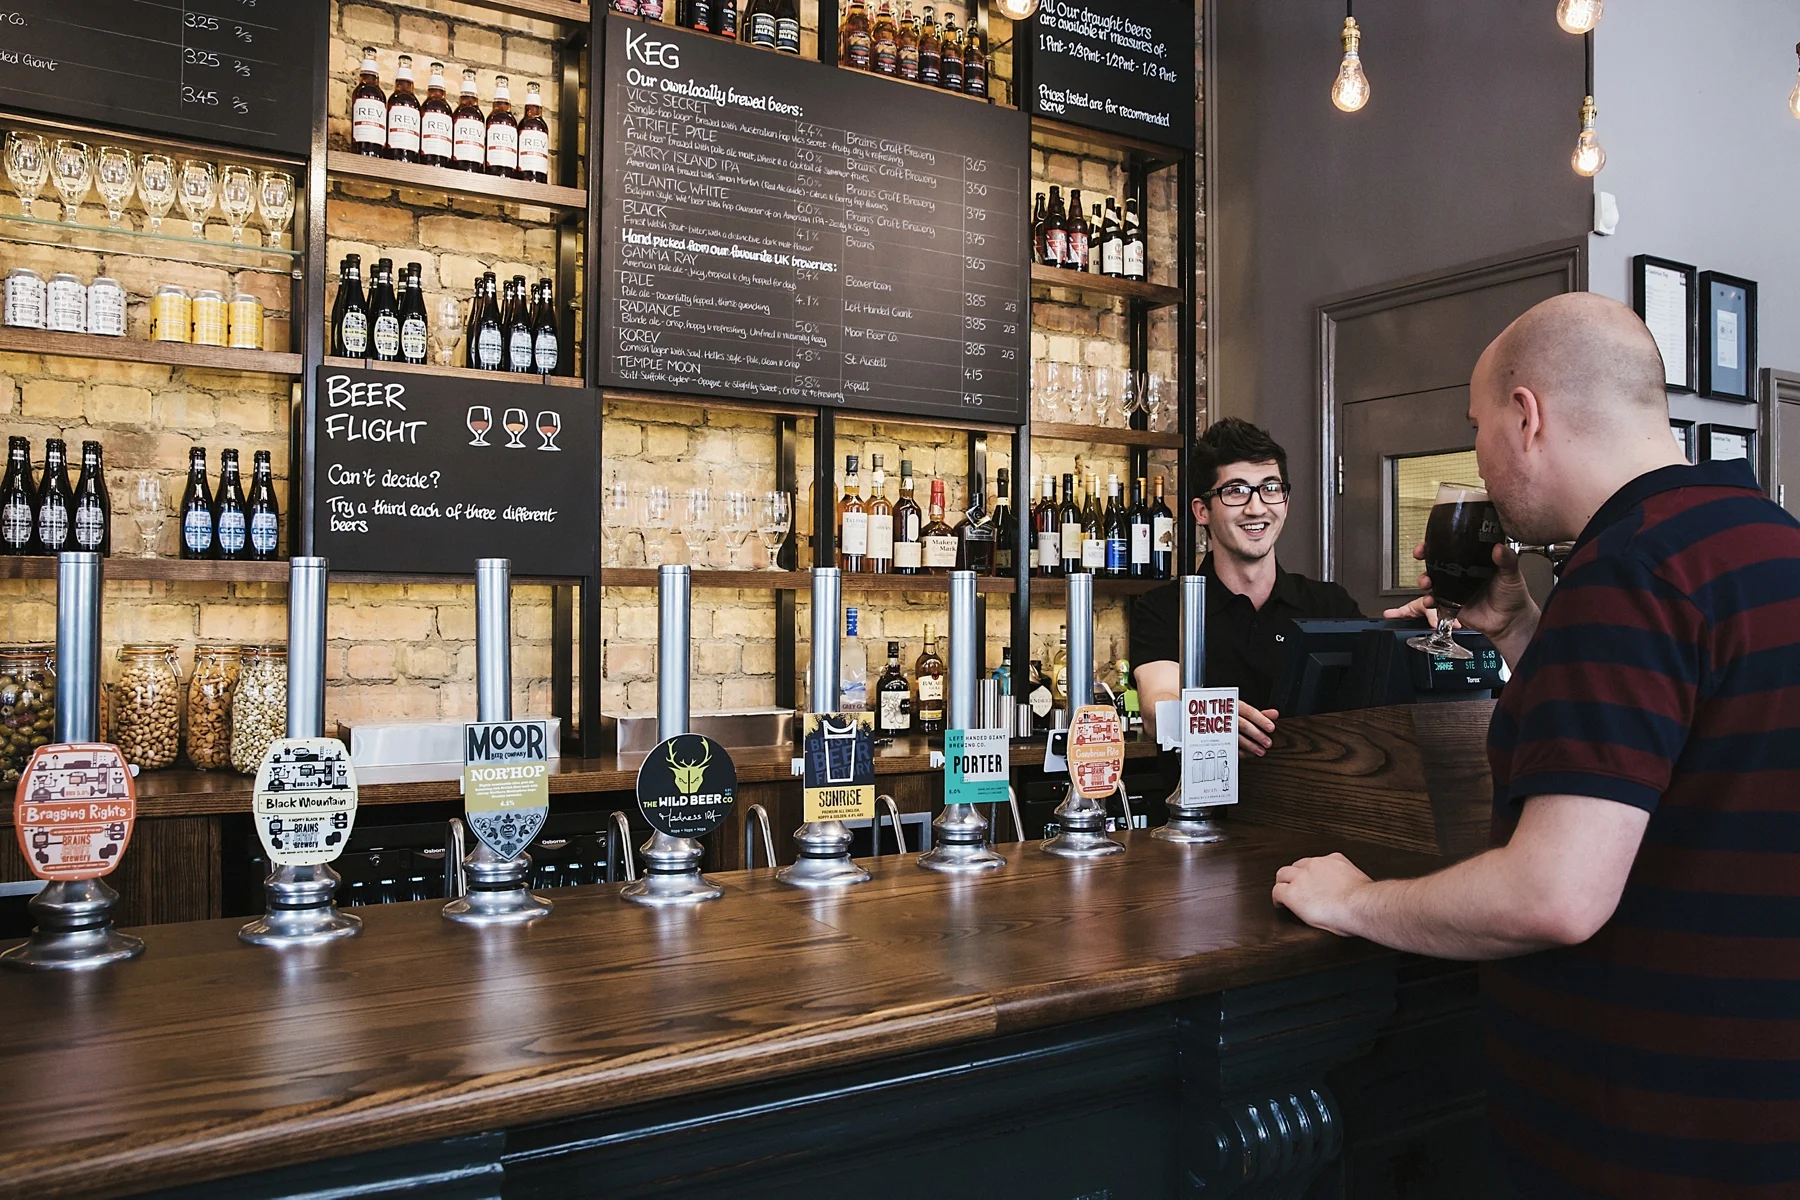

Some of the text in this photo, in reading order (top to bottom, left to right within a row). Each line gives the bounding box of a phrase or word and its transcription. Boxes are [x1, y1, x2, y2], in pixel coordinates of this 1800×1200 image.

[8, 12, 28, 27] Co.
[184, 12, 252, 43] 3.25 2/3
[1039, 0, 1152, 40] All Our draught beers
[1039, 13, 1168, 59] are available in measures of:
[626, 27, 680, 69] KEG
[22, 53, 58, 71] Giant
[183, 47, 251, 77] 3.25 2/3
[1142, 62, 1157, 78] 1/3
[1158, 66, 1178, 84] Pint
[182, 86, 219, 107] 3.45
[626, 68, 657, 88] Our
[728, 87, 766, 111] brewed
[768, 96, 804, 117] beers:
[626, 87, 709, 115] VIC'S SECRET
[1038, 83, 1170, 128] Prices listed are for recommended
[623, 113, 719, 142] A TRIFLE PALE
[797, 122, 823, 138] 4.4%
[847, 131, 878, 149] Brains
[879, 139, 903, 155] Craft
[904, 144, 936, 165] Brewery
[624, 141, 740, 174] BARRY ISLAND IPA
[796, 147, 823, 164] 4.0%
[847, 157, 878, 174] Brains
[879, 164, 903, 179] Craft
[904, 168, 937, 189] Brewery
[623, 171, 731, 200] ATLANTIC WHITE
[622, 199, 668, 219] BLACK
[846, 183, 877, 199] Brains
[878, 189, 902, 204] Craft
[903, 193, 936, 213] Brewery
[845, 209, 874, 225] Brains
[877, 215, 901, 230] Craft
[902, 219, 936, 239] Brewery
[622, 228, 838, 272] Hand picked from our favourite UK breweries:
[846, 235, 875, 251] Brains
[621, 244, 699, 266] GAMMA RAY
[620, 271, 655, 287] PALE
[845, 275, 892, 292] Beavertown
[1004, 302, 1017, 313] 2/3
[619, 299, 681, 318] RADIANCE
[795, 294, 819, 306] 4.1%
[844, 300, 862, 313] Left
[863, 304, 890, 317] Handed
[891, 307, 913, 319] Giant
[1003, 324, 1016, 334] 2/3
[619, 327, 661, 344] KOREV
[845, 326, 865, 339] Moor
[866, 328, 886, 340] Beer
[1001, 349, 1015, 360] 2/3
[617, 355, 701, 374] TEMPLE MOON
[859, 356, 888, 369] Austell
[964, 368, 983, 381] 4.15
[620, 370, 638, 381] Still
[640, 373, 666, 385] Suffolk
[326, 374, 407, 411] BEER
[843, 380, 871, 393] Aspall
[963, 392, 983, 406] 4.15
[325, 413, 428, 445] FLIGHT
[327, 463, 441, 490] Can't decide?
[325, 495, 558, 523] Try a third each of three different
[330, 517, 369, 533] beers
[1483, 660, 1496, 669] 0.00
[1188, 697, 1235, 716] ON THE
[1189, 715, 1233, 734] FENCE
[468, 724, 544, 761] MOOR
[504, 750, 527, 759] COMPANY
[953, 754, 1002, 774] PORTER
[470, 765, 546, 782] NOR'HOP
[266, 796, 346, 809] Black Mountain
[643, 793, 733, 808] THE WILD BEER CO
[818, 788, 863, 808] SUNRISE
[26, 804, 127, 822] Bragging Rights
[704, 809, 722, 822] IPA
[62, 834, 91, 846] BRAINS
[294, 823, 319, 834] BRAINS
